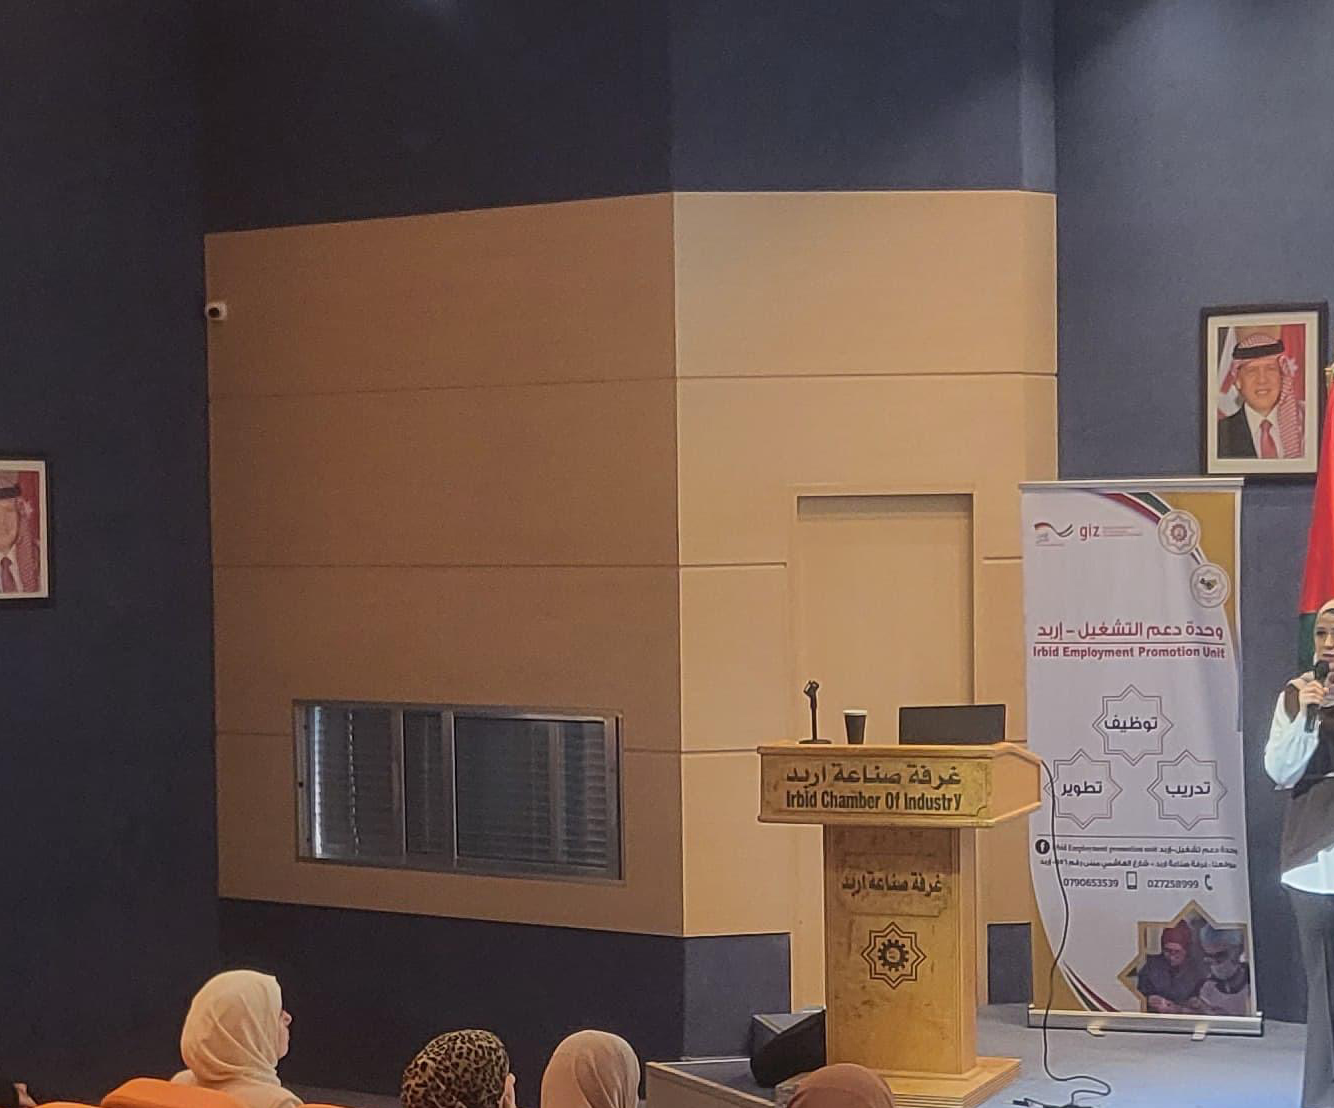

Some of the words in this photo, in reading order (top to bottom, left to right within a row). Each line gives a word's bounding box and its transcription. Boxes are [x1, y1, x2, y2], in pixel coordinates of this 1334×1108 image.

[1079, 523, 1100, 541] giz
[1037, 621, 1063, 640] إربد
[1078, 619, 1142, 640] التشغيل
[1146, 624, 1182, 639] دعم
[1185, 620, 1224, 640] وحدة
[1033, 646, 1059, 657] Irbid
[1063, 646, 1134, 660] Employment
[1138, 646, 1200, 658] Promotion
[1203, 647, 1225, 659] Unit
[1104, 715, 1158, 733] توظيف
[786, 765, 826, 788] اربد
[831, 763, 901, 785] صناعة
[907, 764, 961, 790] غرفة
[1061, 781, 1102, 796] تطوير
[1165, 781, 1211, 798] تدريب
[786, 790, 817, 808] Irbid
[821, 791, 881, 809] Chamber
[885, 792, 900, 809] Of
[867, 871, 908, 891] صناعة
[911, 871, 942, 896] غرفة
